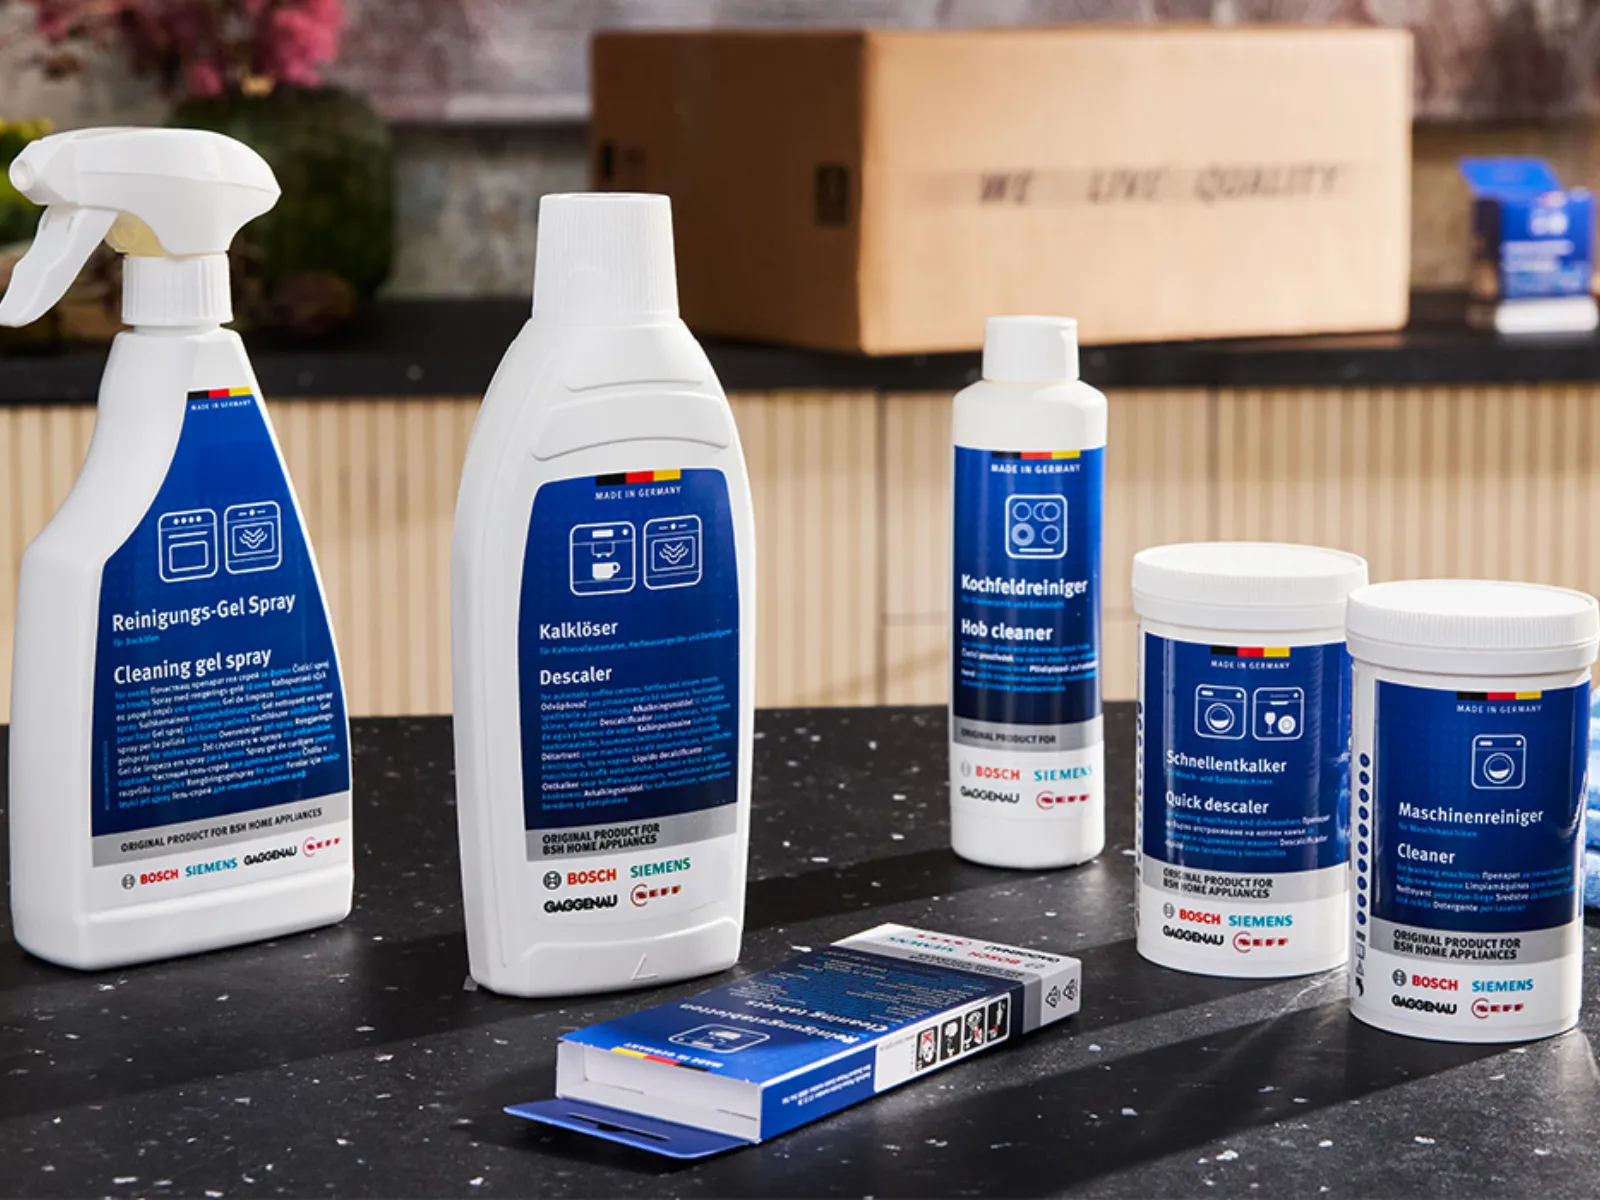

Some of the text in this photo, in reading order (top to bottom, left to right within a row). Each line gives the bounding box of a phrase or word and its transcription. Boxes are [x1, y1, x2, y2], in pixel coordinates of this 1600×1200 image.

[220, 399, 251, 408] GERMANY
[990, 464, 1081, 474] MADE IN GERMANY
[595, 486, 682, 500] MADE IN GERMANY
[961, 573, 1089, 599] Kochfeldreiniger
[112, 593, 296, 632] Reinigungs-Gel Spray
[540, 620, 619, 640] Kalklöser
[961, 618, 1054, 641] Hob cleaner
[113, 660, 192, 684] Cleaning
[195, 652, 222, 678] gel
[225, 649, 272, 673] spray
[1211, 660, 1290, 670] MADE IN GERMANY
[540, 666, 612, 685] Descaler
[1456, 704, 1542, 714] MADE IN GERMANY
[1038, 735, 1056, 744] FOR
[1166, 750, 1288, 773] Schnellentkalker
[976, 765, 1020, 781] BOSCH
[960, 786, 1020, 804] GAGGENAU
[1166, 790, 1269, 814] Quick descaler
[1398, 802, 1544, 827] Maschinenreiniger
[120, 808, 323, 852] ORIGINAL PRODUCT FOR BSH HOME APPLIANCES
[542, 822, 660, 844] ORIGINAL PRODUCT FOR
[542, 834, 657, 856] BSH HOME APPLIANCES
[1397, 842, 1456, 864] Cleaner
[140, 868, 179, 885] BOSCH
[185, 857, 238, 878] SIEMENS
[244, 846, 297, 867] GAGGENAU
[567, 857, 692, 886] BOSCH SIEMENS
[1163, 878, 1179, 891] BSH
[1208, 885, 1270, 898] APPLIANCES
[1204, 875, 1251, 888] PRODUCT
[1253, 878, 1274, 888] FOR
[544, 894, 618, 914] GAGGENAU
[1179, 908, 1293, 928] BOSCH SIEMENS
[1162, 925, 1224, 946] GAGGENAU
[1393, 928, 1520, 949] ORIGINAL PRODUCT FOR
[1393, 942, 1517, 960] BSH HOME APPLIANCES
[1412, 974, 1534, 992] BOSCH SIEMENS
[1391, 994, 1457, 1016] GAGGENAU
